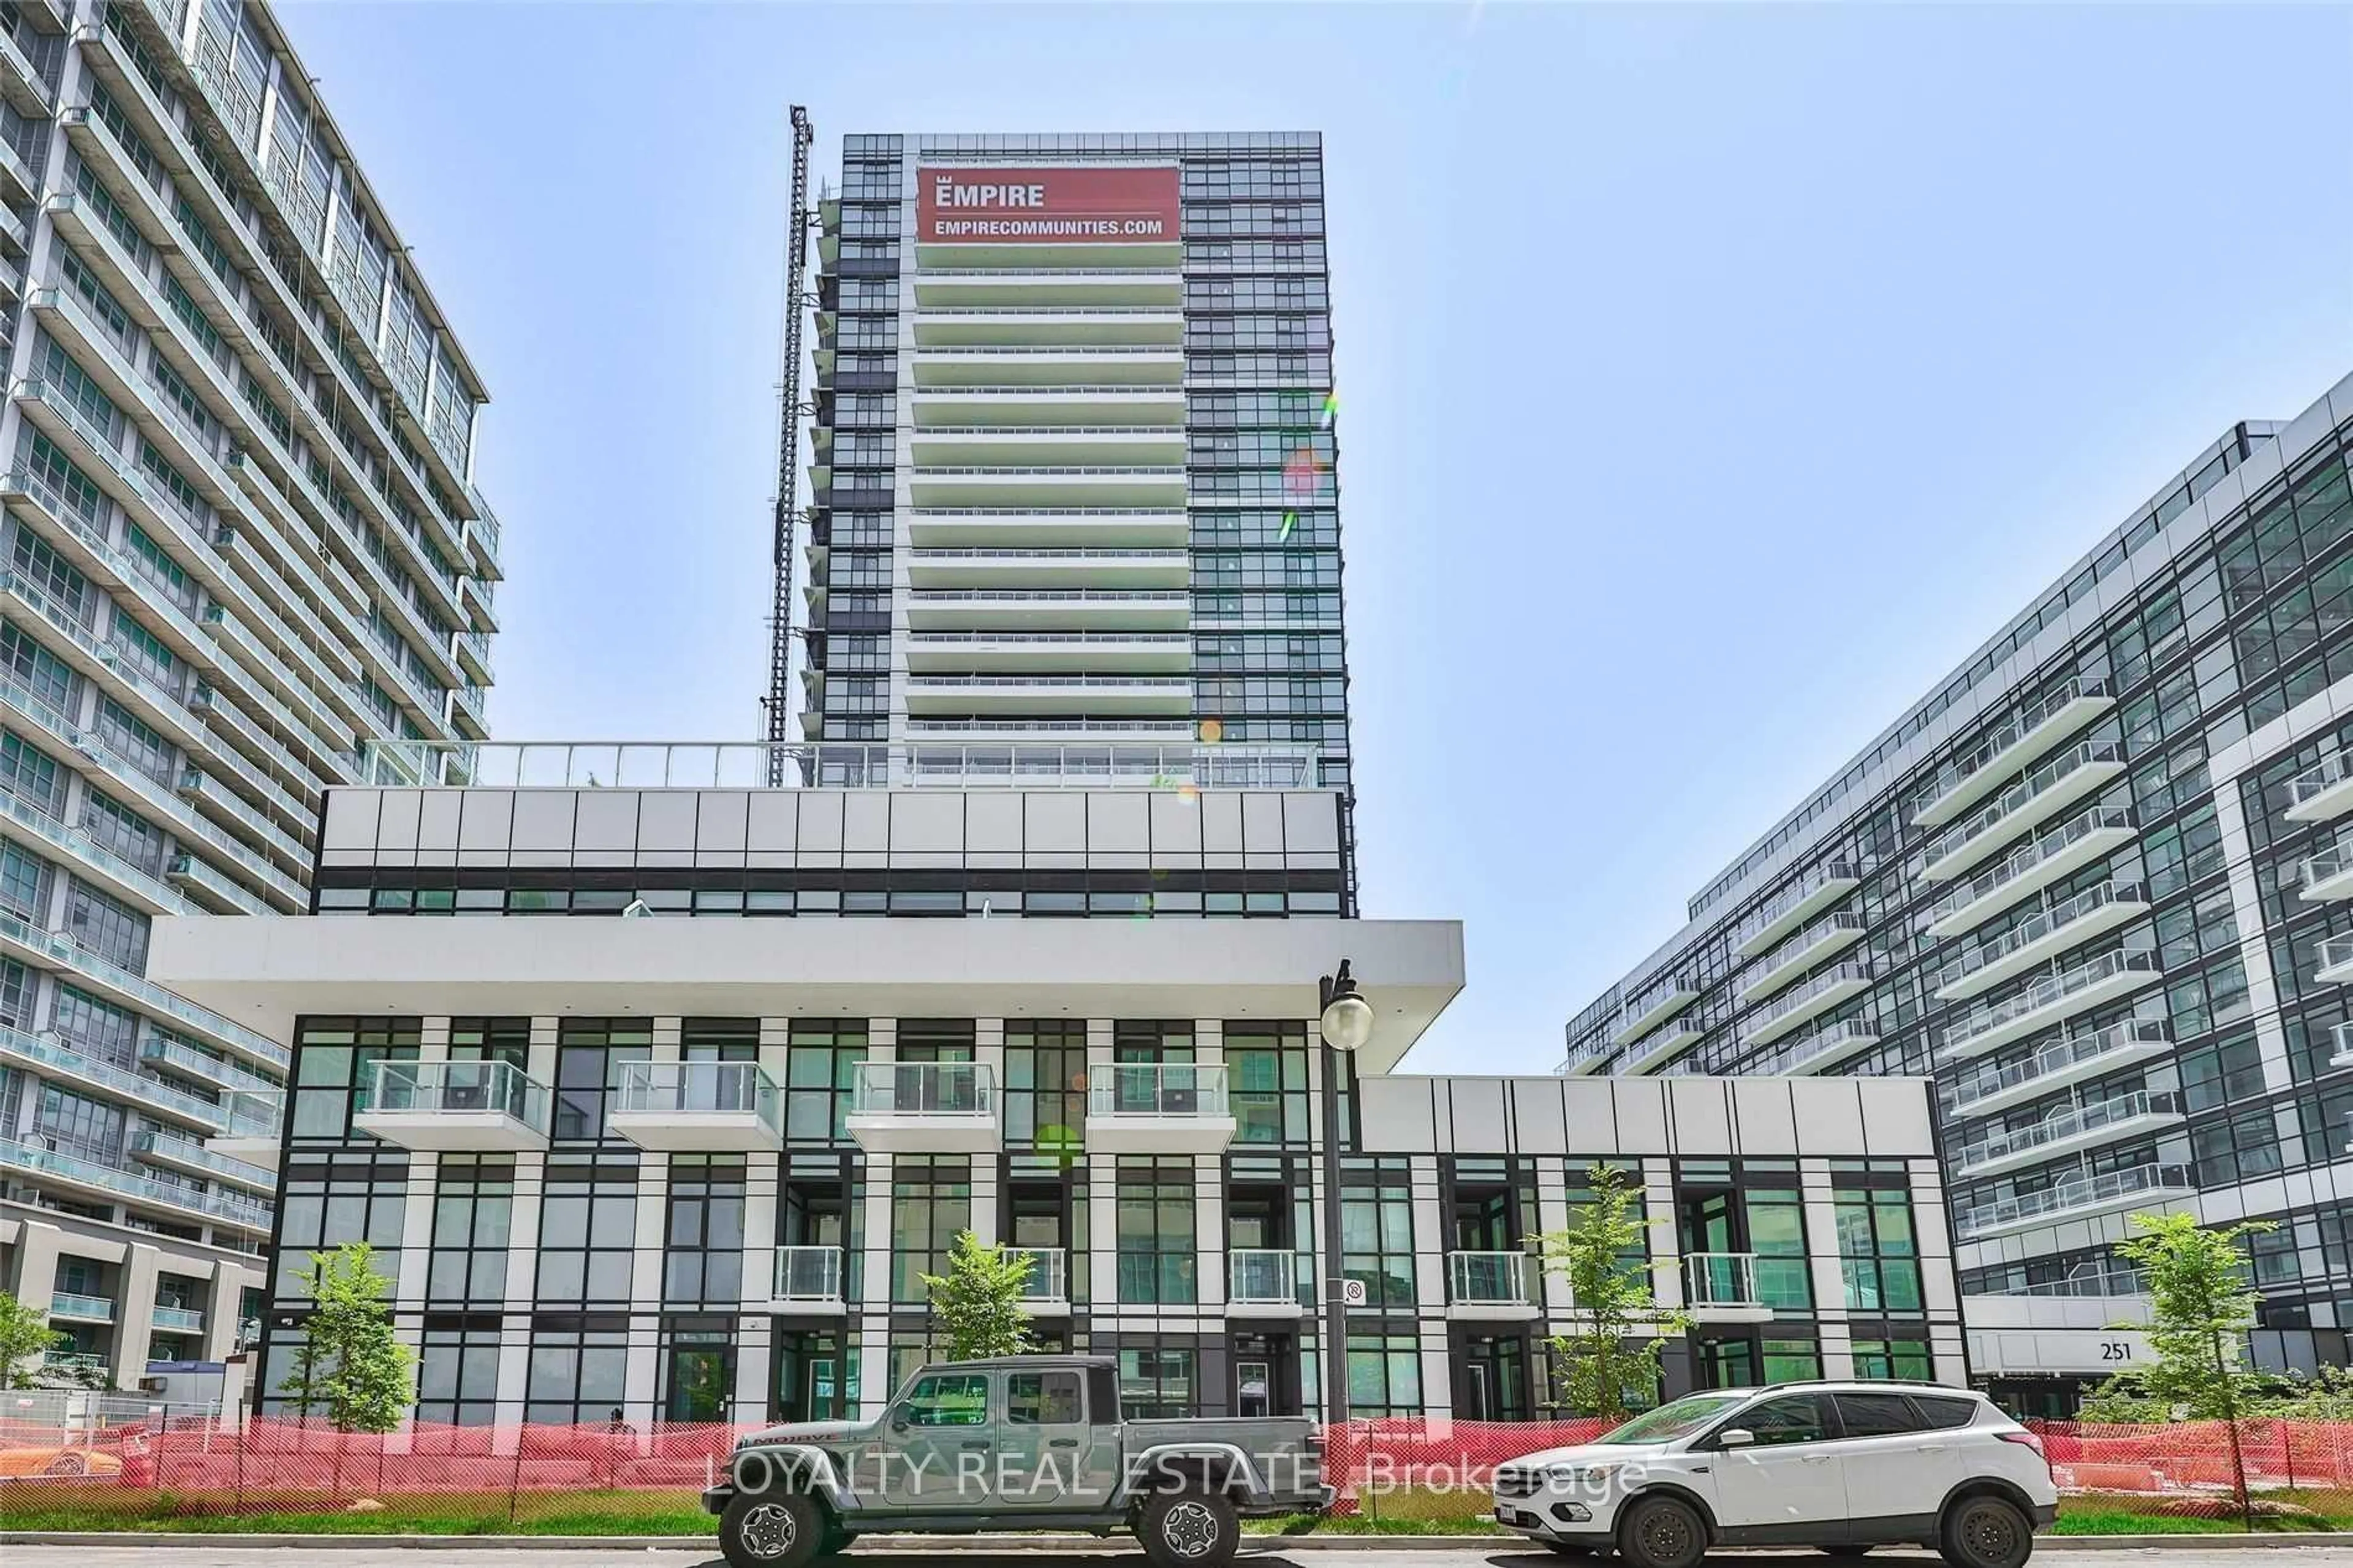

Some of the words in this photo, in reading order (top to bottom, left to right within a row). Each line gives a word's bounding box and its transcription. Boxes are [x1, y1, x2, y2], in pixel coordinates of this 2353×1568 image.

[936, 184, 1045, 207] EMPIRE
[935, 220, 1162, 235] EMPIRECOMMUNITIES.COM
[2100, 1343, 2131, 1360] 251
